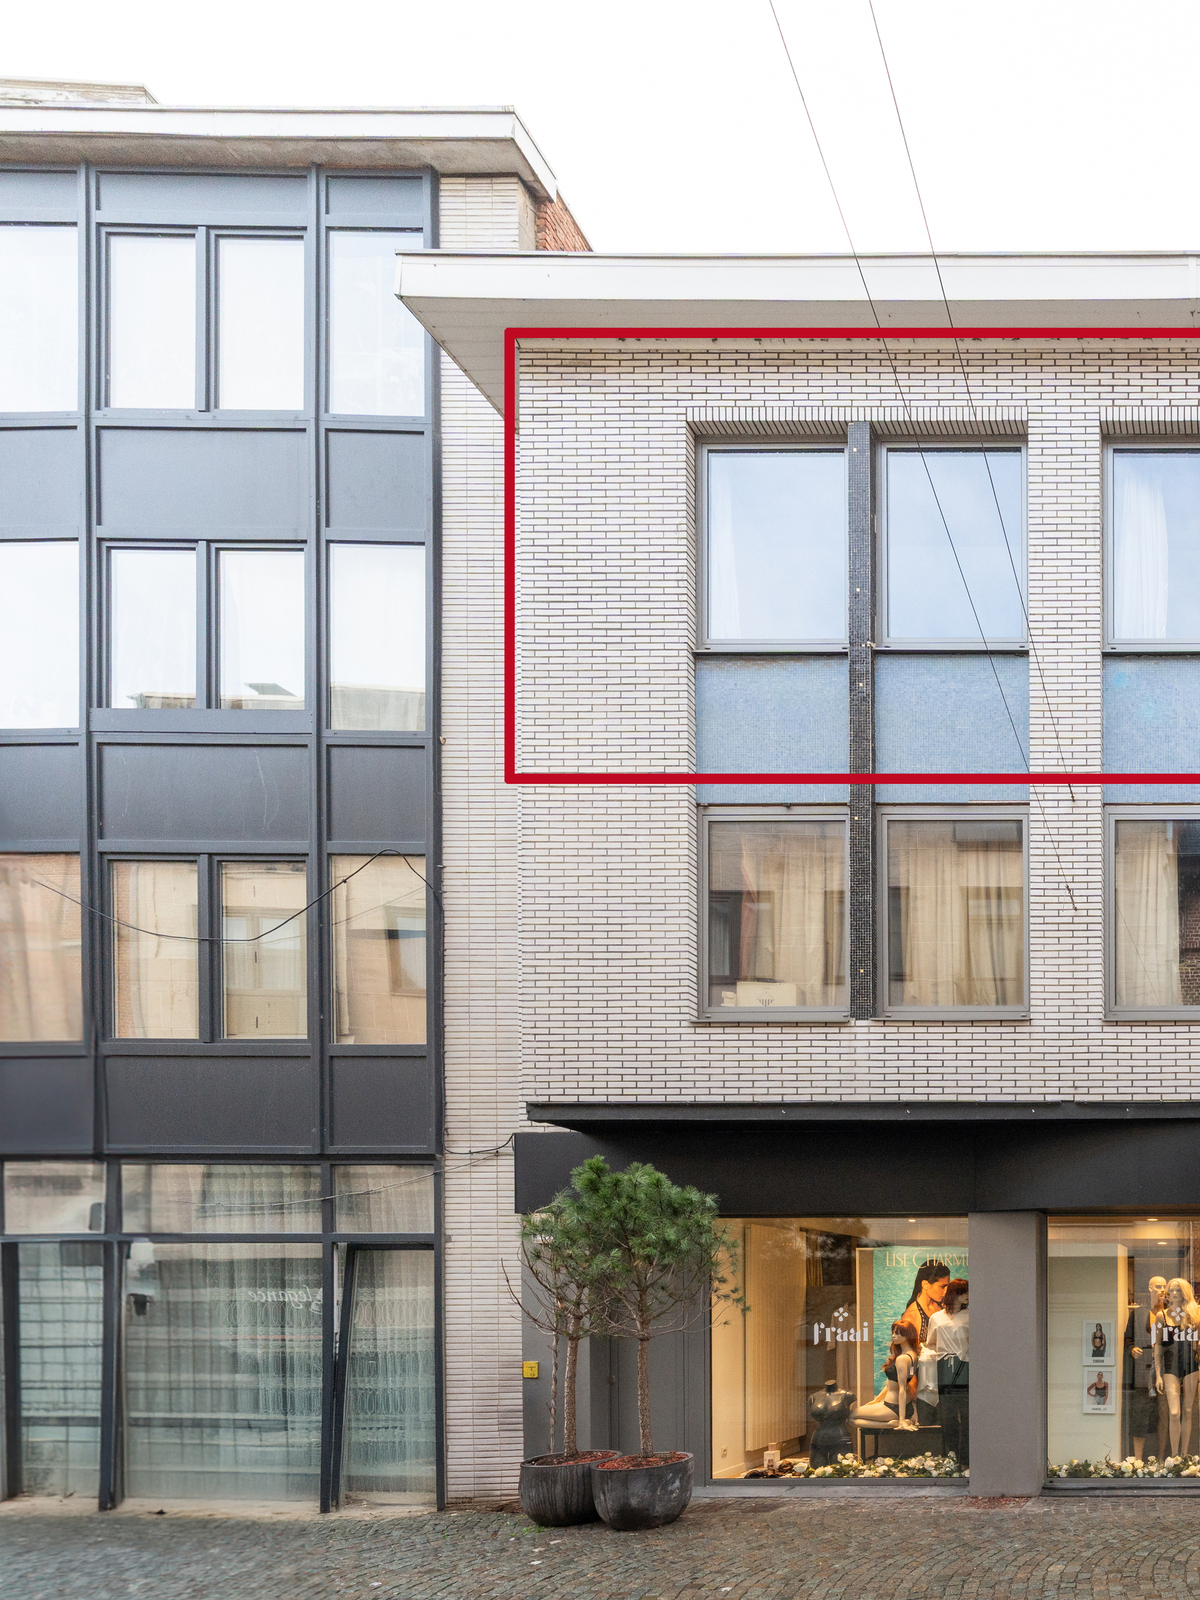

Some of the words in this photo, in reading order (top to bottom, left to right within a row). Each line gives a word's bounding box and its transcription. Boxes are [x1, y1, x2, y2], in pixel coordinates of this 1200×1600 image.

[886, 1251, 910, 1267] LISE
[912, 1250, 969, 1269] CHARM
[813, 1321, 869, 1346] fraai
